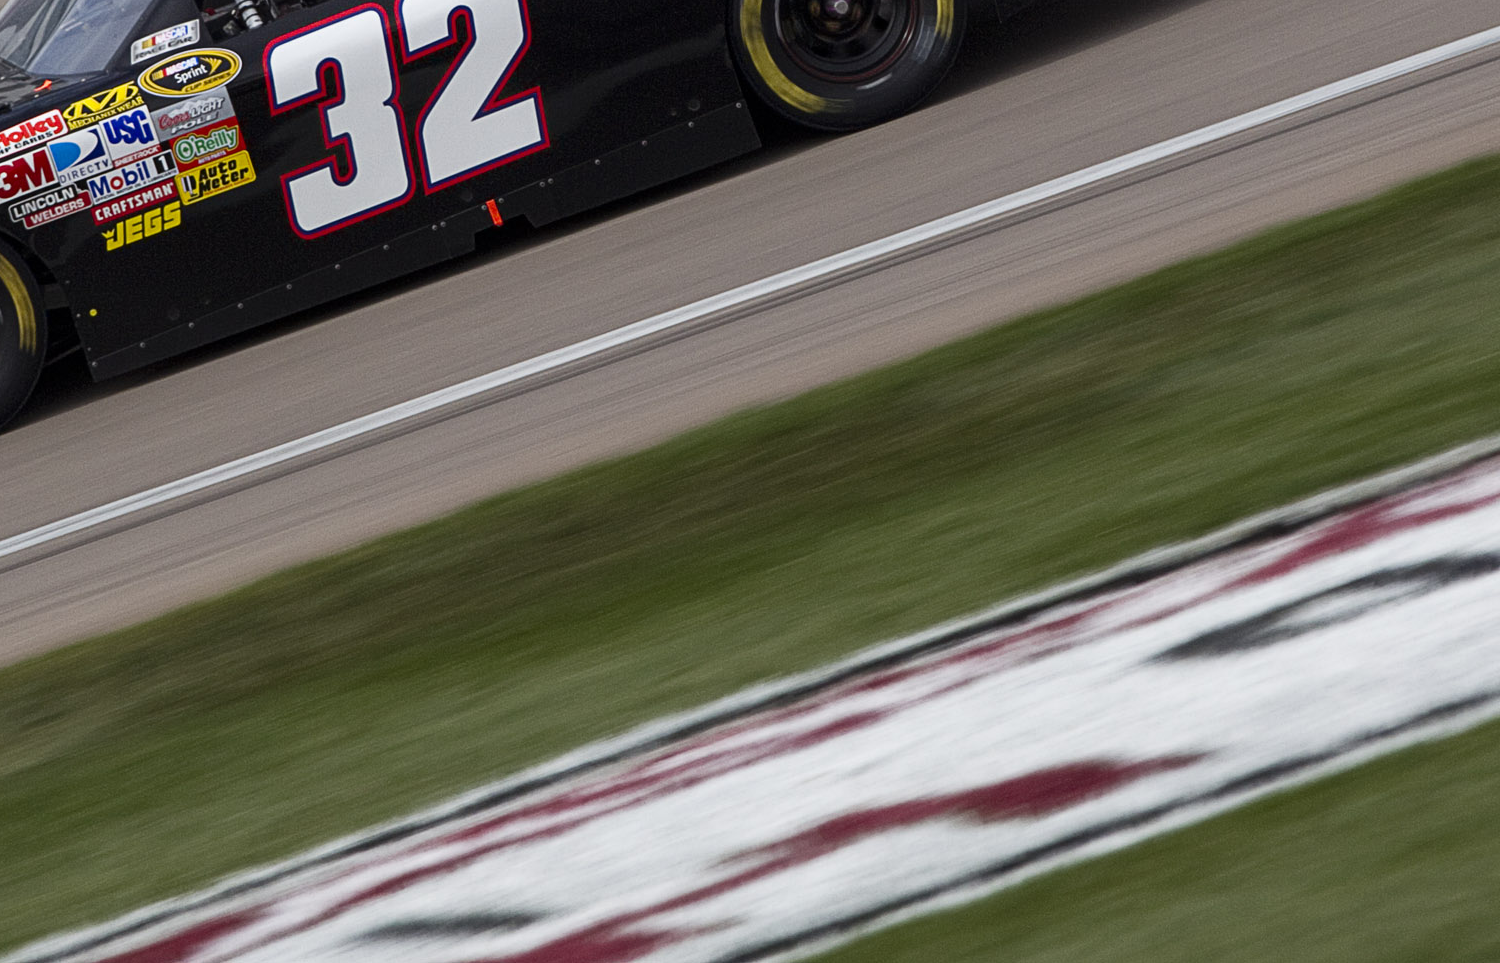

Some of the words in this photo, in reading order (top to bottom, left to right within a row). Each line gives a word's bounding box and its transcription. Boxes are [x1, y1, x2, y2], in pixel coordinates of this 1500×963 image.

[135, 44, 166, 59] RACE
[168, 37, 193, 48] CAR
[155, 25, 189, 43] NASCAR
[165, 57, 200, 76] NASCAR
[174, 64, 208, 83] Sprint
[184, 83, 202, 93] CUP
[204, 72, 231, 85] SERIES
[67, 109, 117, 130] MECHANIX
[117, 95, 144, 113] WEAR
[158, 110, 190, 130] Coors
[190, 97, 225, 118] LIGHT
[14, 131, 53, 149] CARBS
[103, 110, 154, 144] USG
[177, 127, 236, 160] O'Reilly
[60, 158, 109, 184] DIRECTV
[89, 161, 151, 198] Mobil
[158, 155, 169, 171] 1
[199, 159, 237, 180] Auto
[199, 167, 249, 197] Meter
[13, 186, 75, 218] LINCOLN
[30, 198, 85, 224] WELDERS
[94, 186, 173, 221] CRAFTSMAN
[106, 200, 181, 251] JEGS
